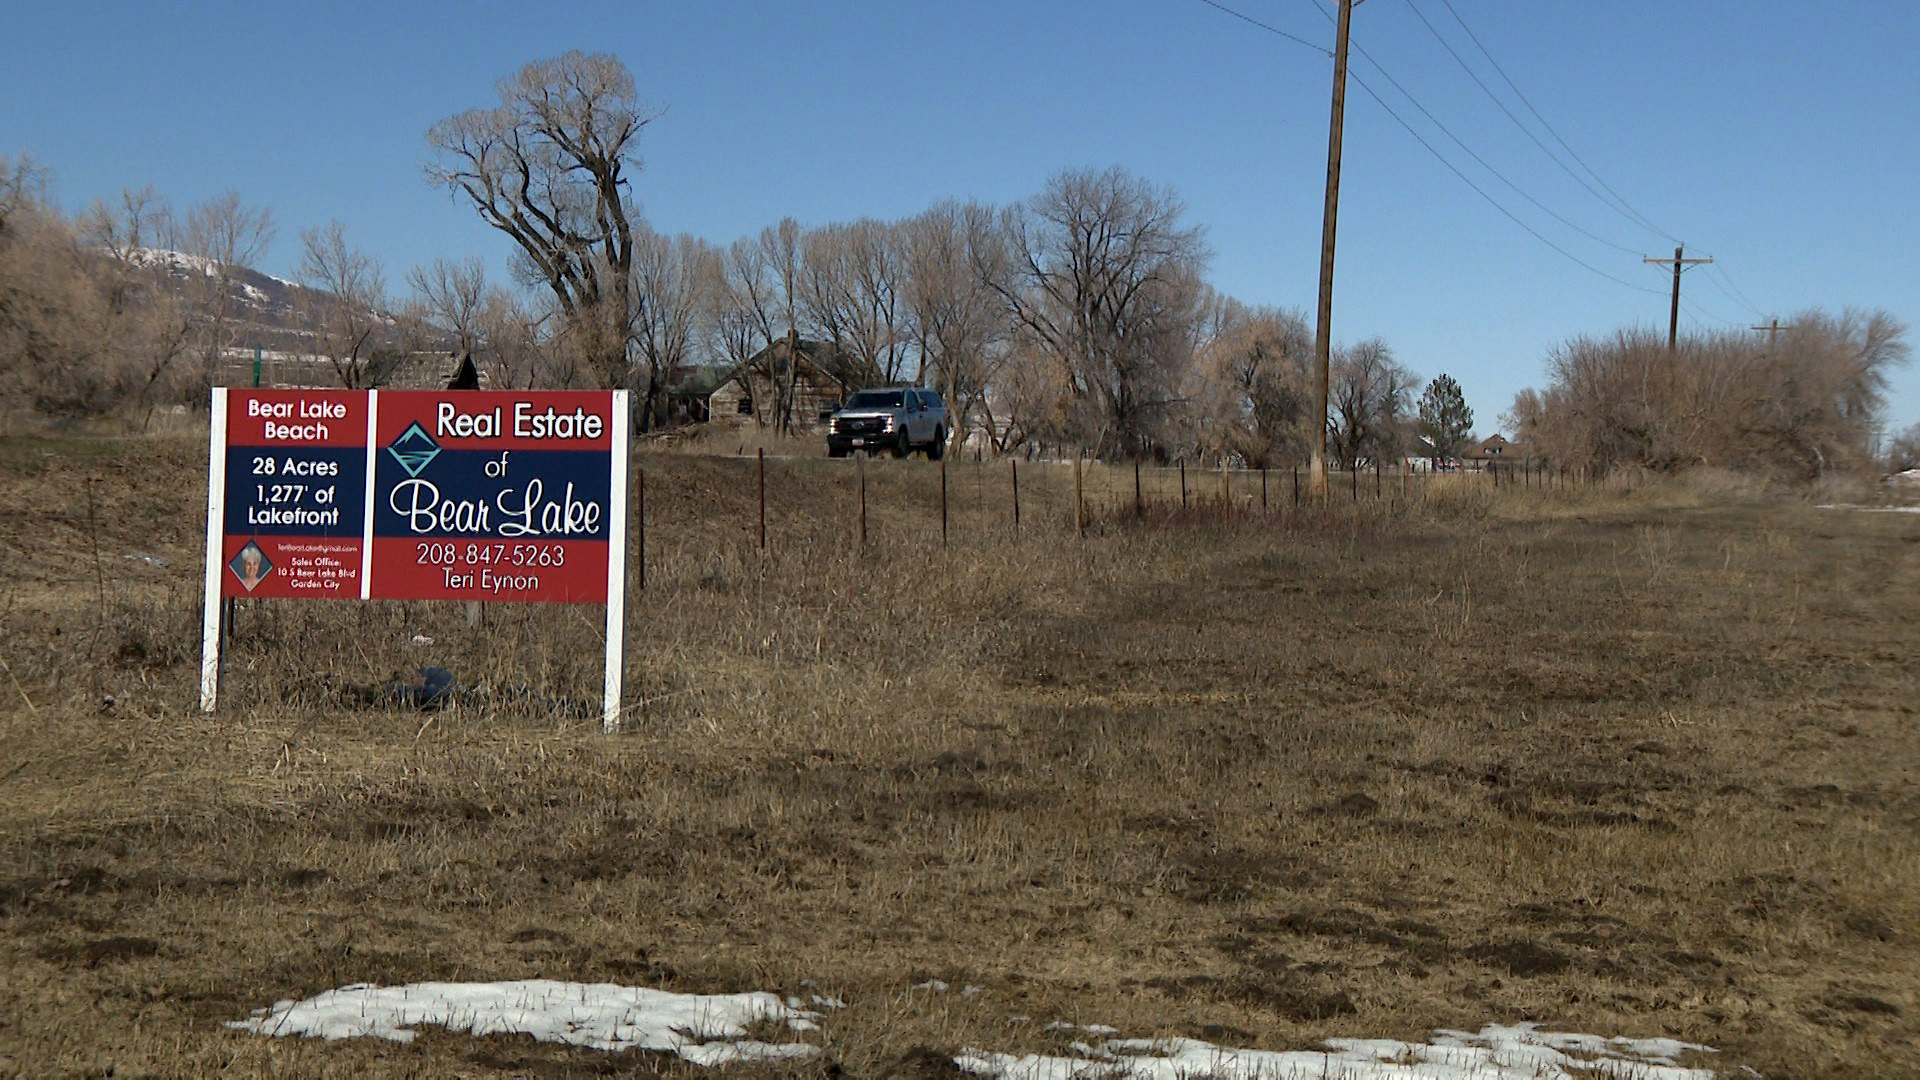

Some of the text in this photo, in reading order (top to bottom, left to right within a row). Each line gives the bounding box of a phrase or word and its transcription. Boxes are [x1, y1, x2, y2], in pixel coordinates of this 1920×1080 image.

[248, 399, 346, 419] Bear Lake
[437, 402, 603, 438] Real Estate
[264, 421, 328, 440] Beach
[252, 457, 338, 476] 28 Acres
[484, 451, 510, 478] of
[257, 485, 335, 505] 1,277' of
[248, 506, 340, 526] Lakefront
[389, 478, 600, 537] Bear Lake
[291, 557, 313, 567] Sales
[416, 543, 565, 567] 208-847-5263
[277, 567, 356, 578] 10 S Bear Lake Blvd
[442, 567, 539, 594] Teri Eynon
[290, 579, 340, 590] Garden City
